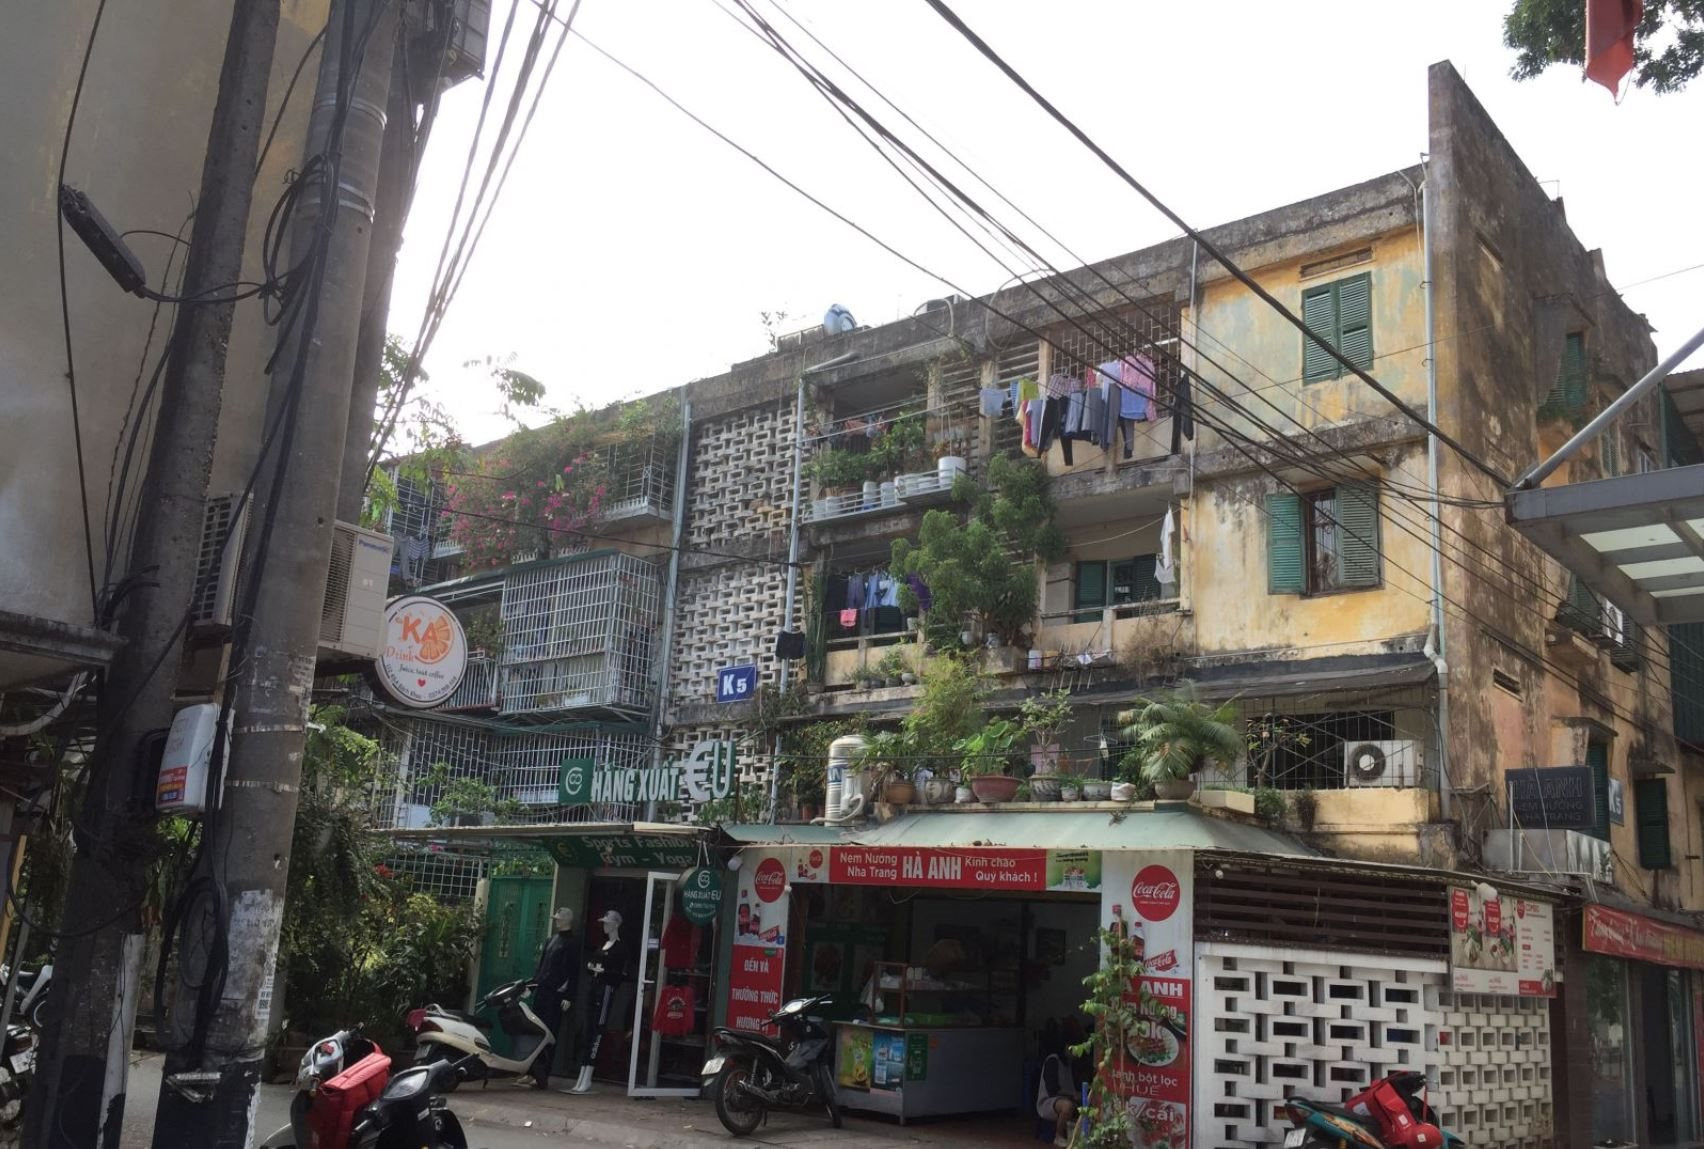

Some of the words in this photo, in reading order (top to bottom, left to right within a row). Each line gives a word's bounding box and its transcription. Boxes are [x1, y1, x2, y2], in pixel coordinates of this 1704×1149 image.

[402, 616, 438, 644] KA
[592, 764, 635, 801] HÀNG
[638, 758, 680, 801] XUẤT
[582, 835, 632, 851] Sports
[600, 852, 638, 867] Gym
[654, 851, 695, 867] Yoga
[840, 851, 862, 864] Nem
[902, 850, 923, 879] HÀ
[927, 856, 962, 880] ANH
[847, 866, 867, 877] Nha
[869, 866, 897, 880] Trang
[1000, 870, 1031, 882] khách
[1132, 881, 1177, 900] Coca-Cola
[1140, 980, 1184, 998] ANH
